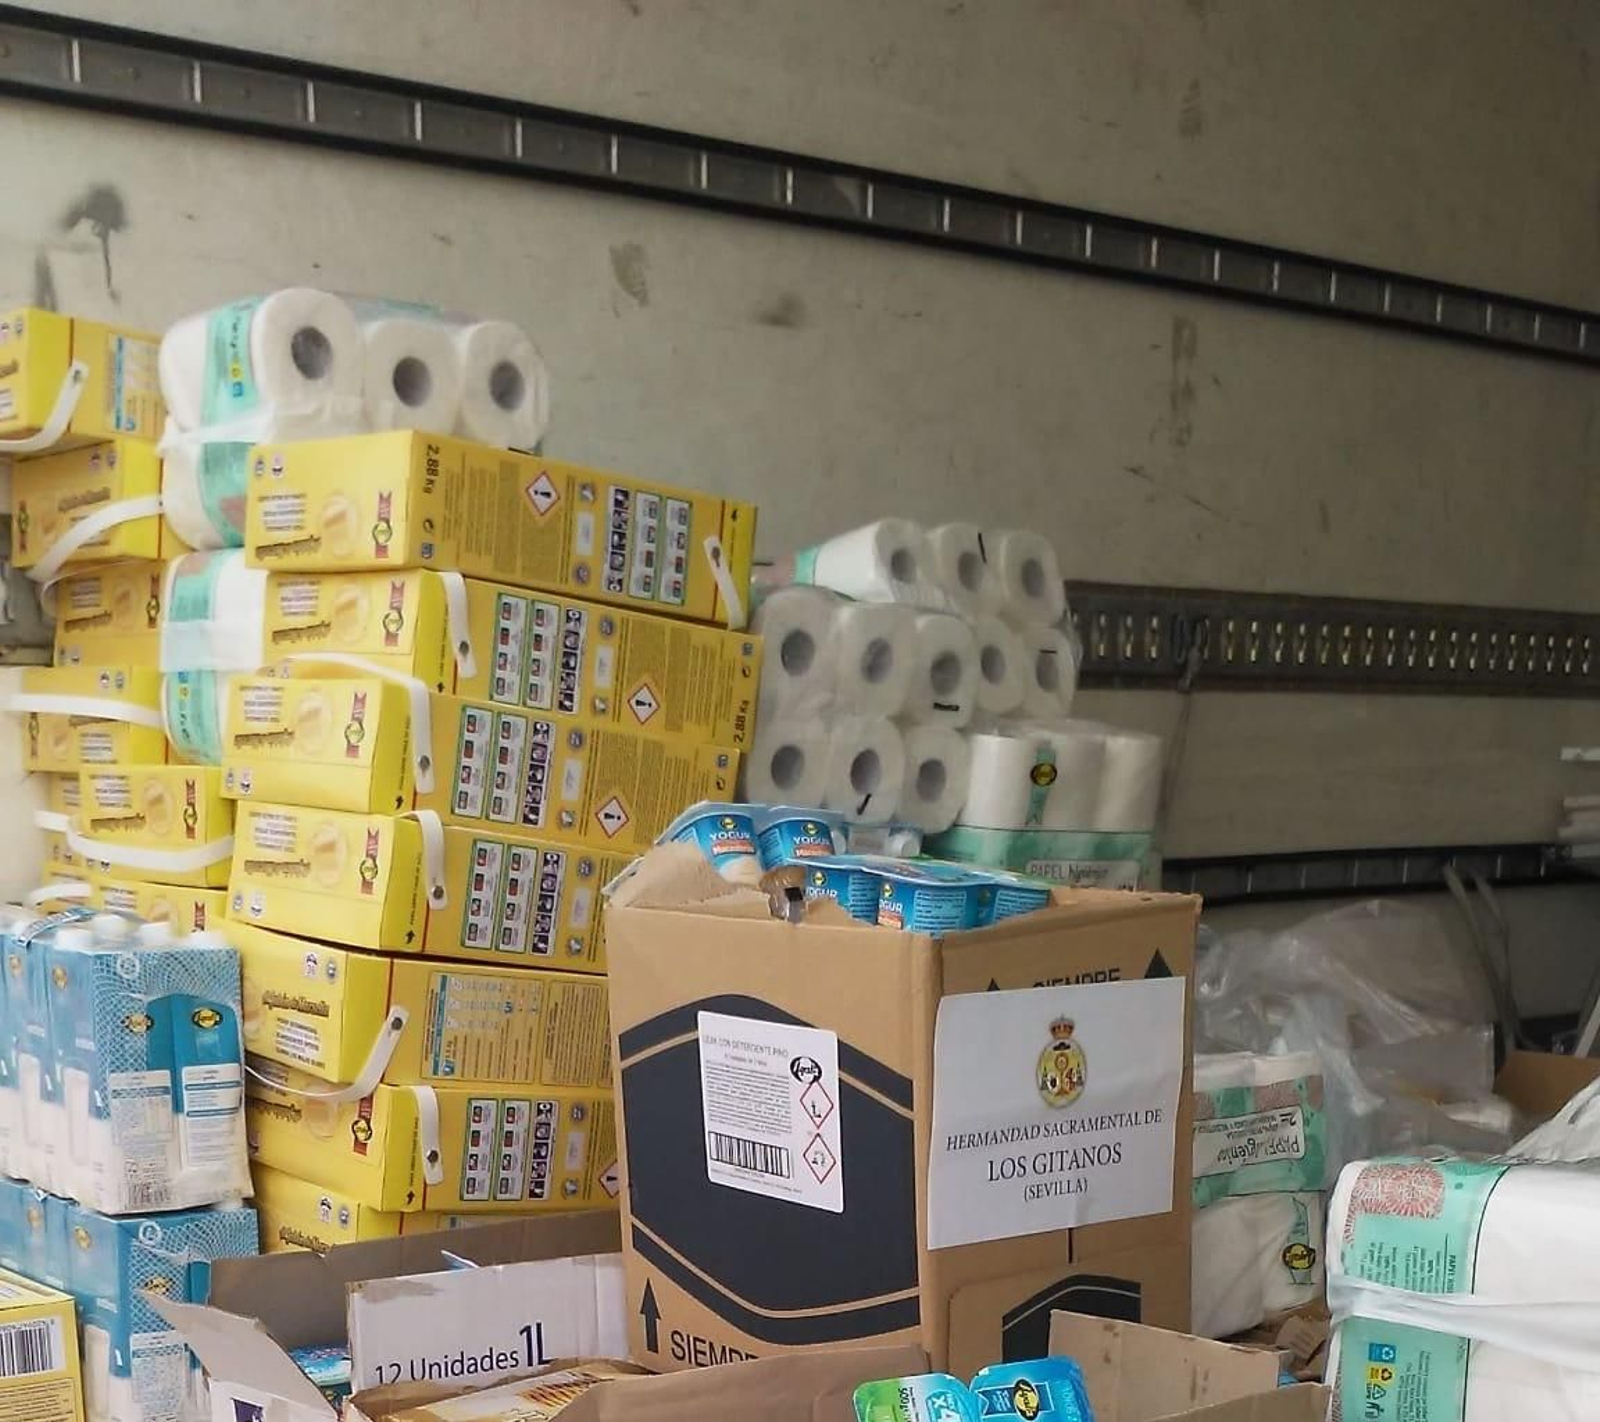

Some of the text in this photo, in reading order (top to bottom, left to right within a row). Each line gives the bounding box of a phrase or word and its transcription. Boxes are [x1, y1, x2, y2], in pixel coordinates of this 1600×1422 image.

[426, 444, 440, 477] 2.88
[733, 714, 747, 743] 2.88
[946, 1109, 1163, 1152] HERMANDAD SACRAMENTAL DE
[988, 1142, 1122, 1182] LOS GITANOS
[1024, 1177, 1088, 1203] (SEVILLA)
[375, 1322, 553, 1383] 12 Unidades 1L
[671, 1330, 759, 1367] SIEMP
